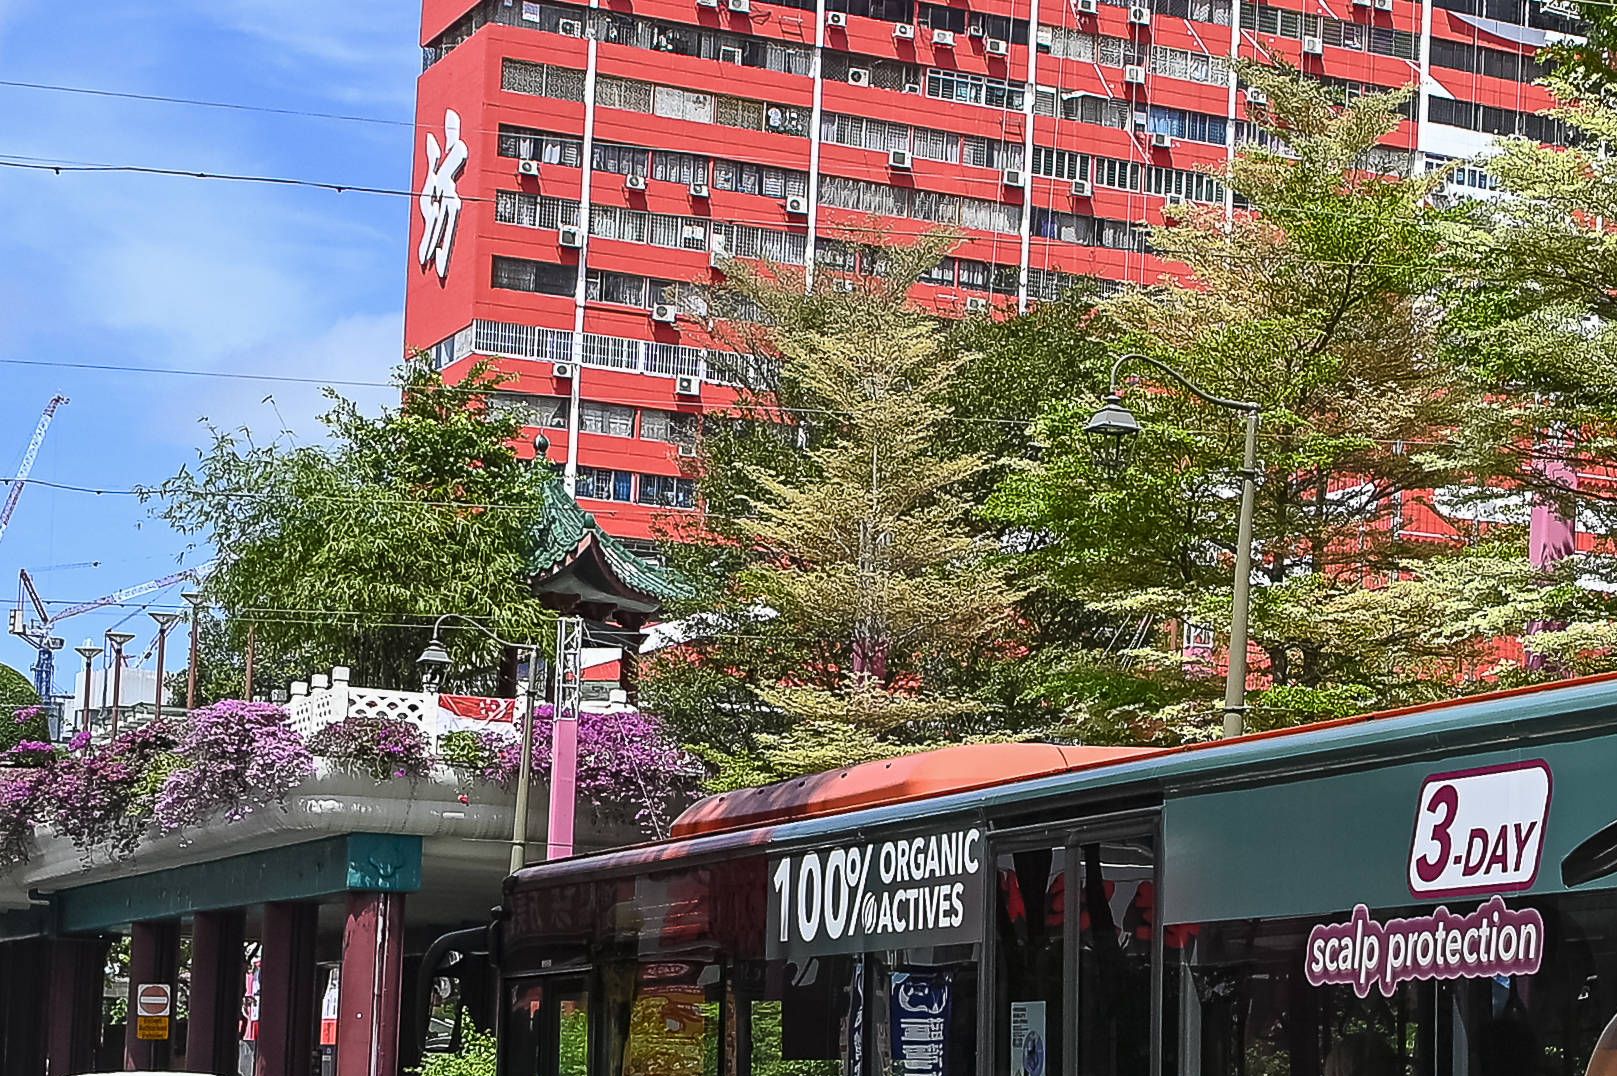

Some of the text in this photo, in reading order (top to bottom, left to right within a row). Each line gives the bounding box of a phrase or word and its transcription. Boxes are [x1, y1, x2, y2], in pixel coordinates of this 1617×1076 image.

[1416, 784, 1538, 882] 3-DAY
[774, 829, 980, 942] 100% ORGANIC
[876, 883, 964, 934] ACTIVES
[1311, 911, 1537, 984] scalp protection
